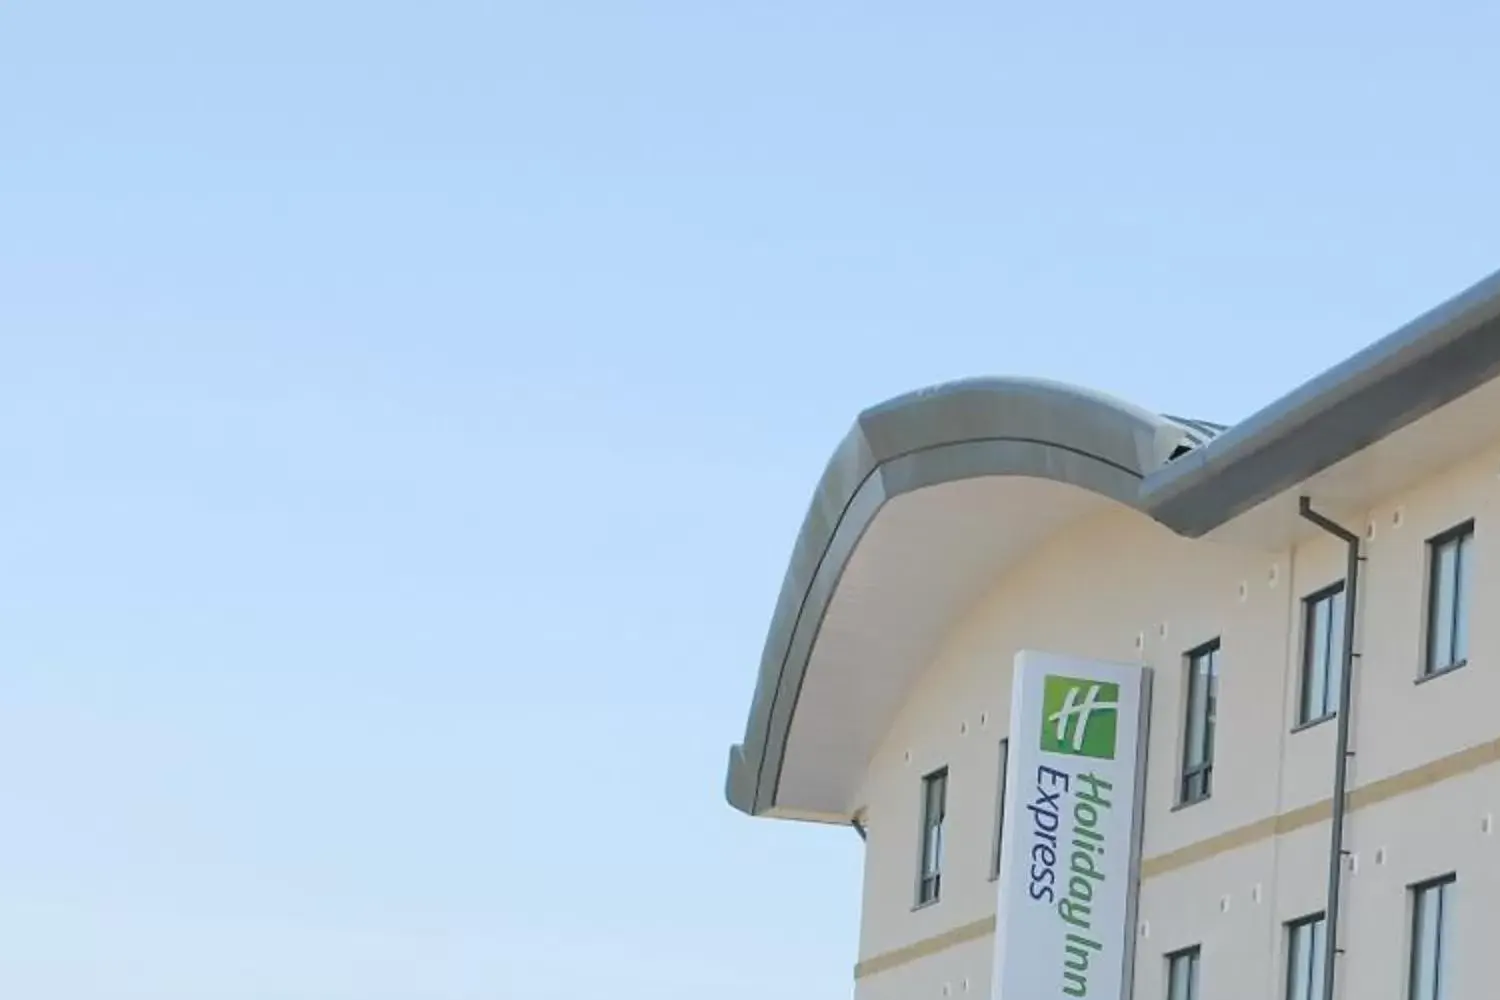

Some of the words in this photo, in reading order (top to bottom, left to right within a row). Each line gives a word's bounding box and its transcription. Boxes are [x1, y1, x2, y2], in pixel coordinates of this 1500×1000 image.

[1048, 685, 1119, 753] H
[1027, 764, 1069, 904] Express
[1058, 771, 1113, 930] Holiday
[1061, 932, 1102, 999] Inn
